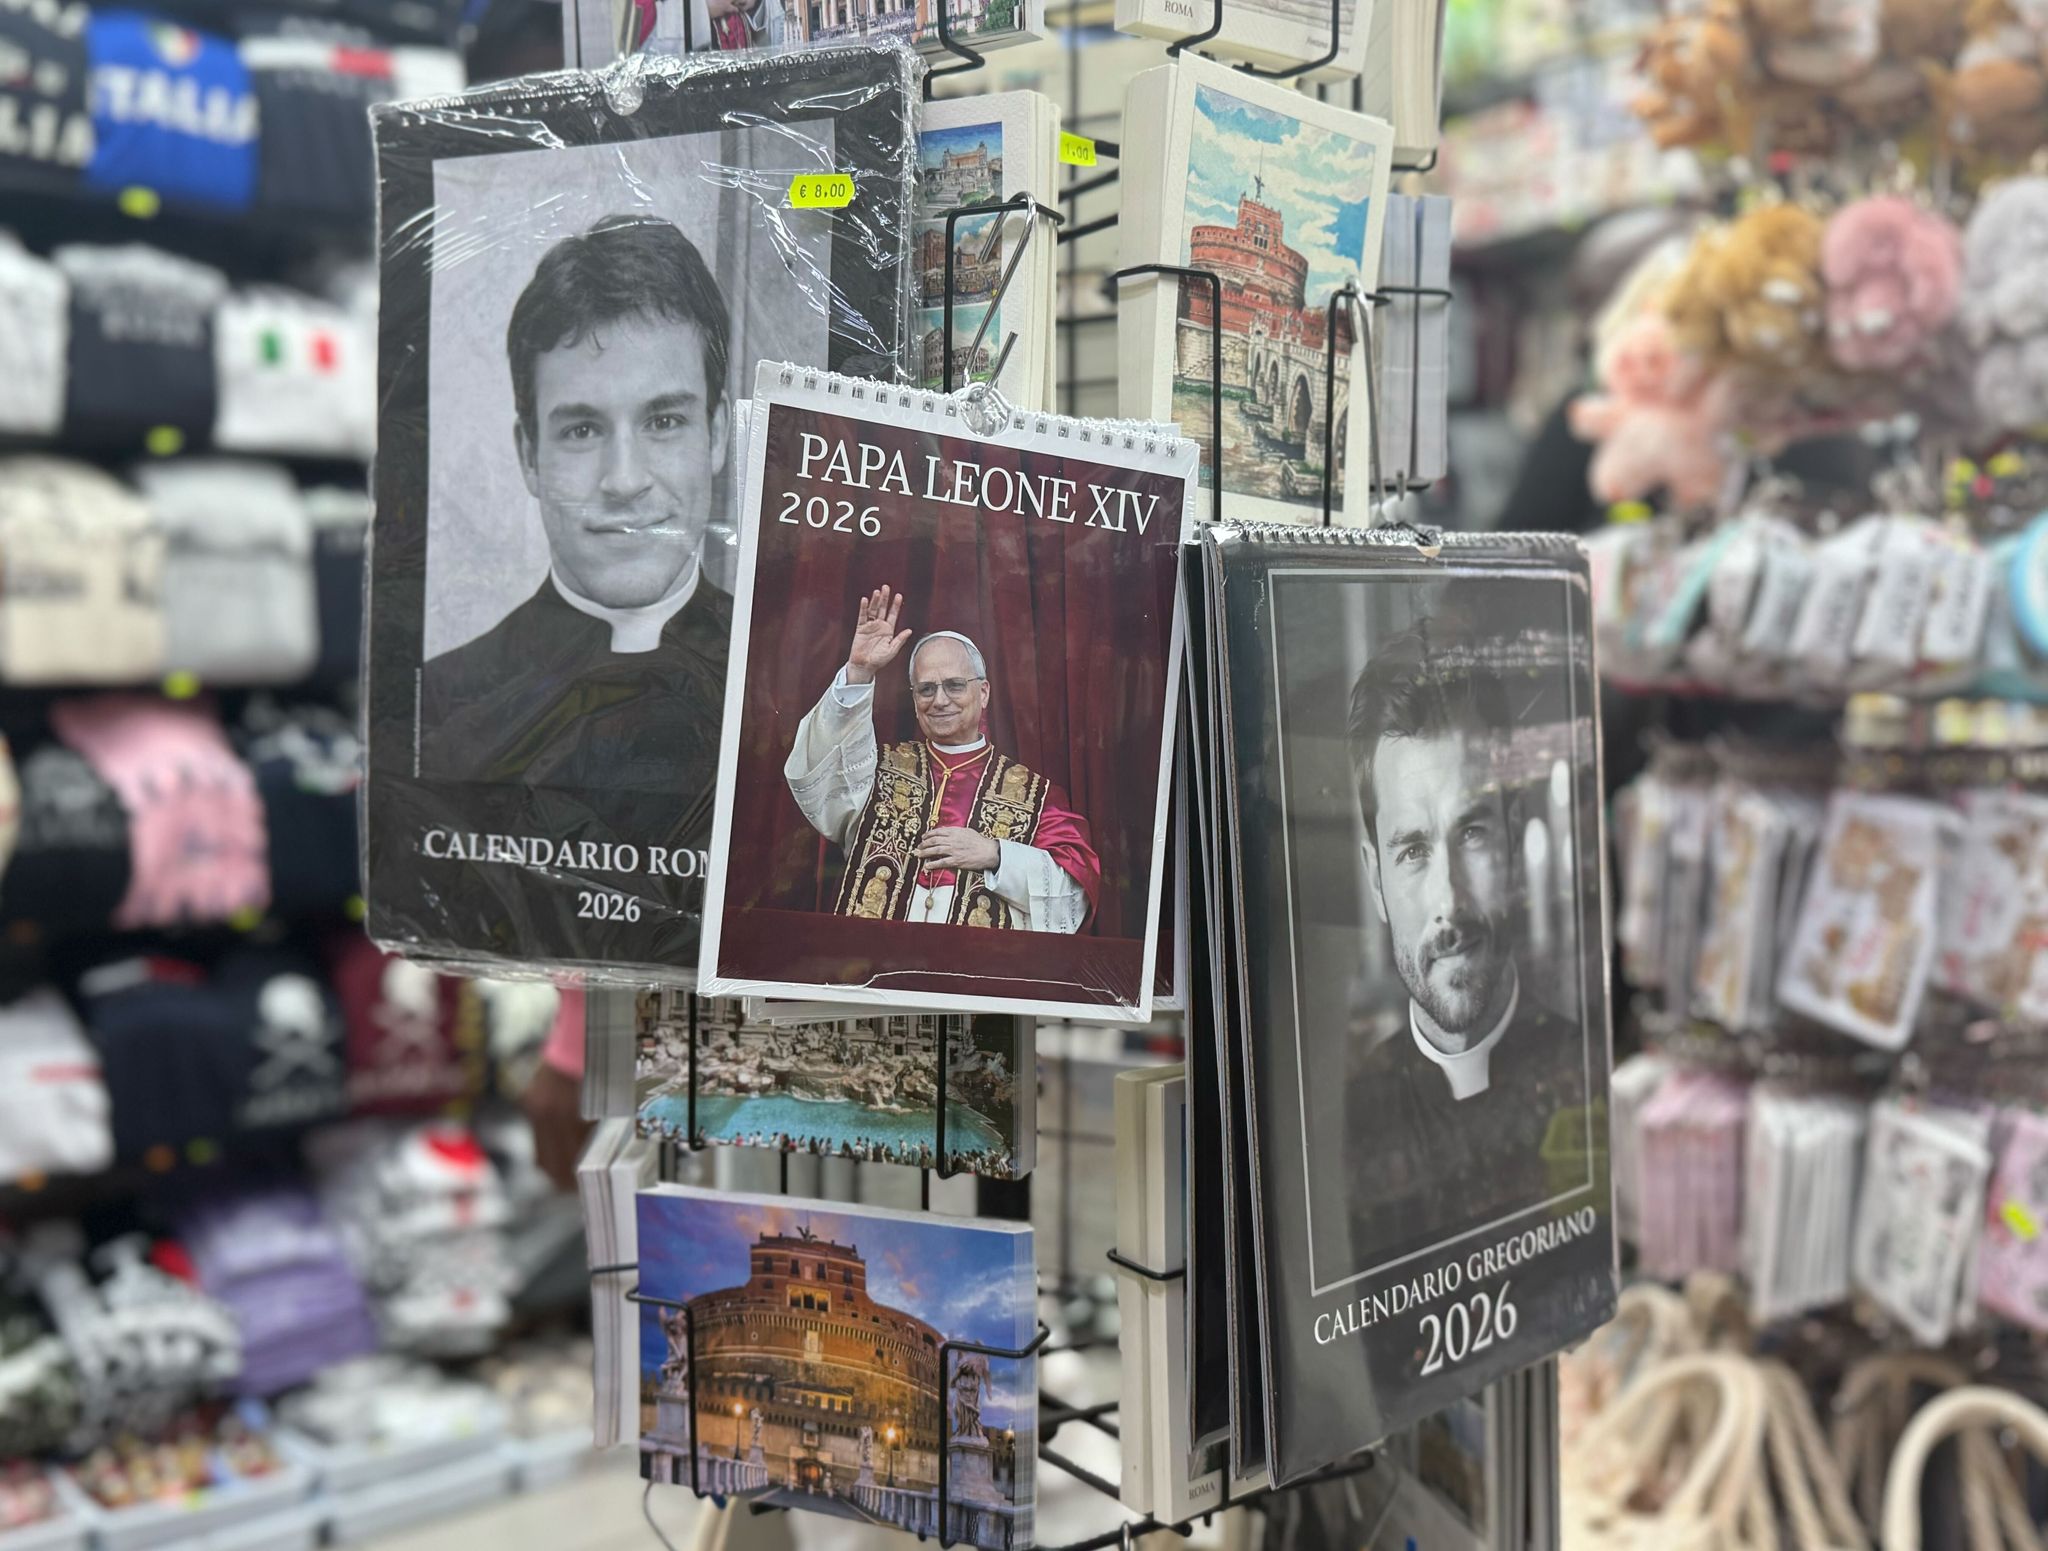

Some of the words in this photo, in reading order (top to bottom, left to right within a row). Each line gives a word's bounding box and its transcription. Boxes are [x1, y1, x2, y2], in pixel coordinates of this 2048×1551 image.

[1164, 0, 1193, 18] ROMA
[799, 184, 807, 198] €
[797, 432, 914, 497] PAPA
[922, 454, 1077, 524] LEONE
[1084, 483, 1160, 536] XIV
[778, 491, 882, 537] 2026
[424, 829, 640, 873] CALENDARIO
[577, 891, 642, 923] 2026
[1313, 1261, 1462, 1345] CALENDARIO
[1466, 1205, 1597, 1283] GREGORIANO
[1418, 1280, 1518, 1377] 2026
[1188, 1481, 1216, 1501] ROMA
